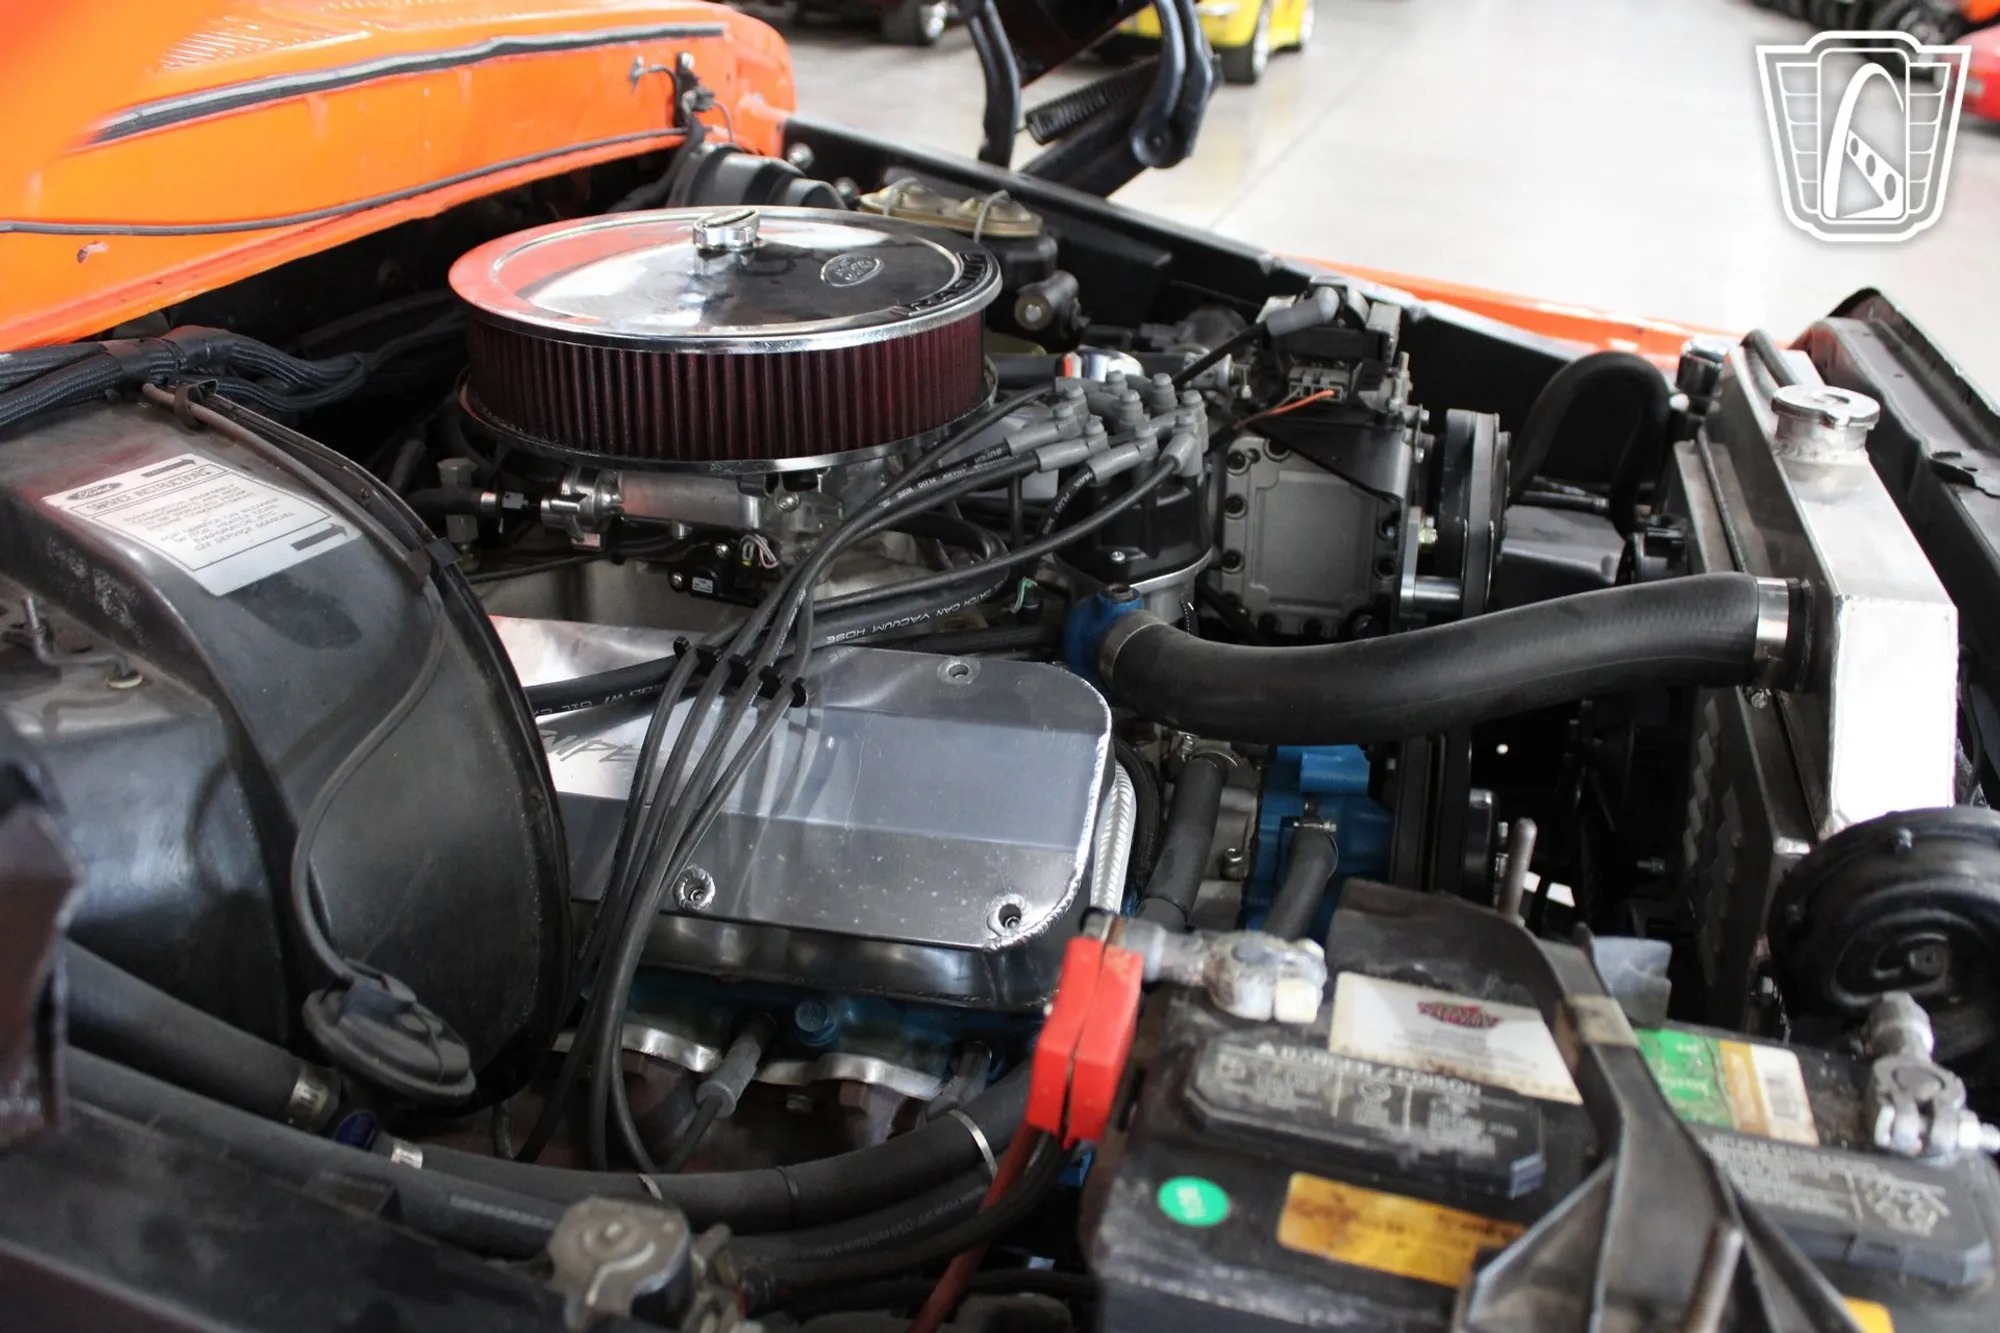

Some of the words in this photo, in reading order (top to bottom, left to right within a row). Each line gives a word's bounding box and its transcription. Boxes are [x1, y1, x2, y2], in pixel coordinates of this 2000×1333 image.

[936, 603, 960, 617] CAN
[872, 612, 931, 633] VACUUM
[825, 628, 866, 645] HOSE
